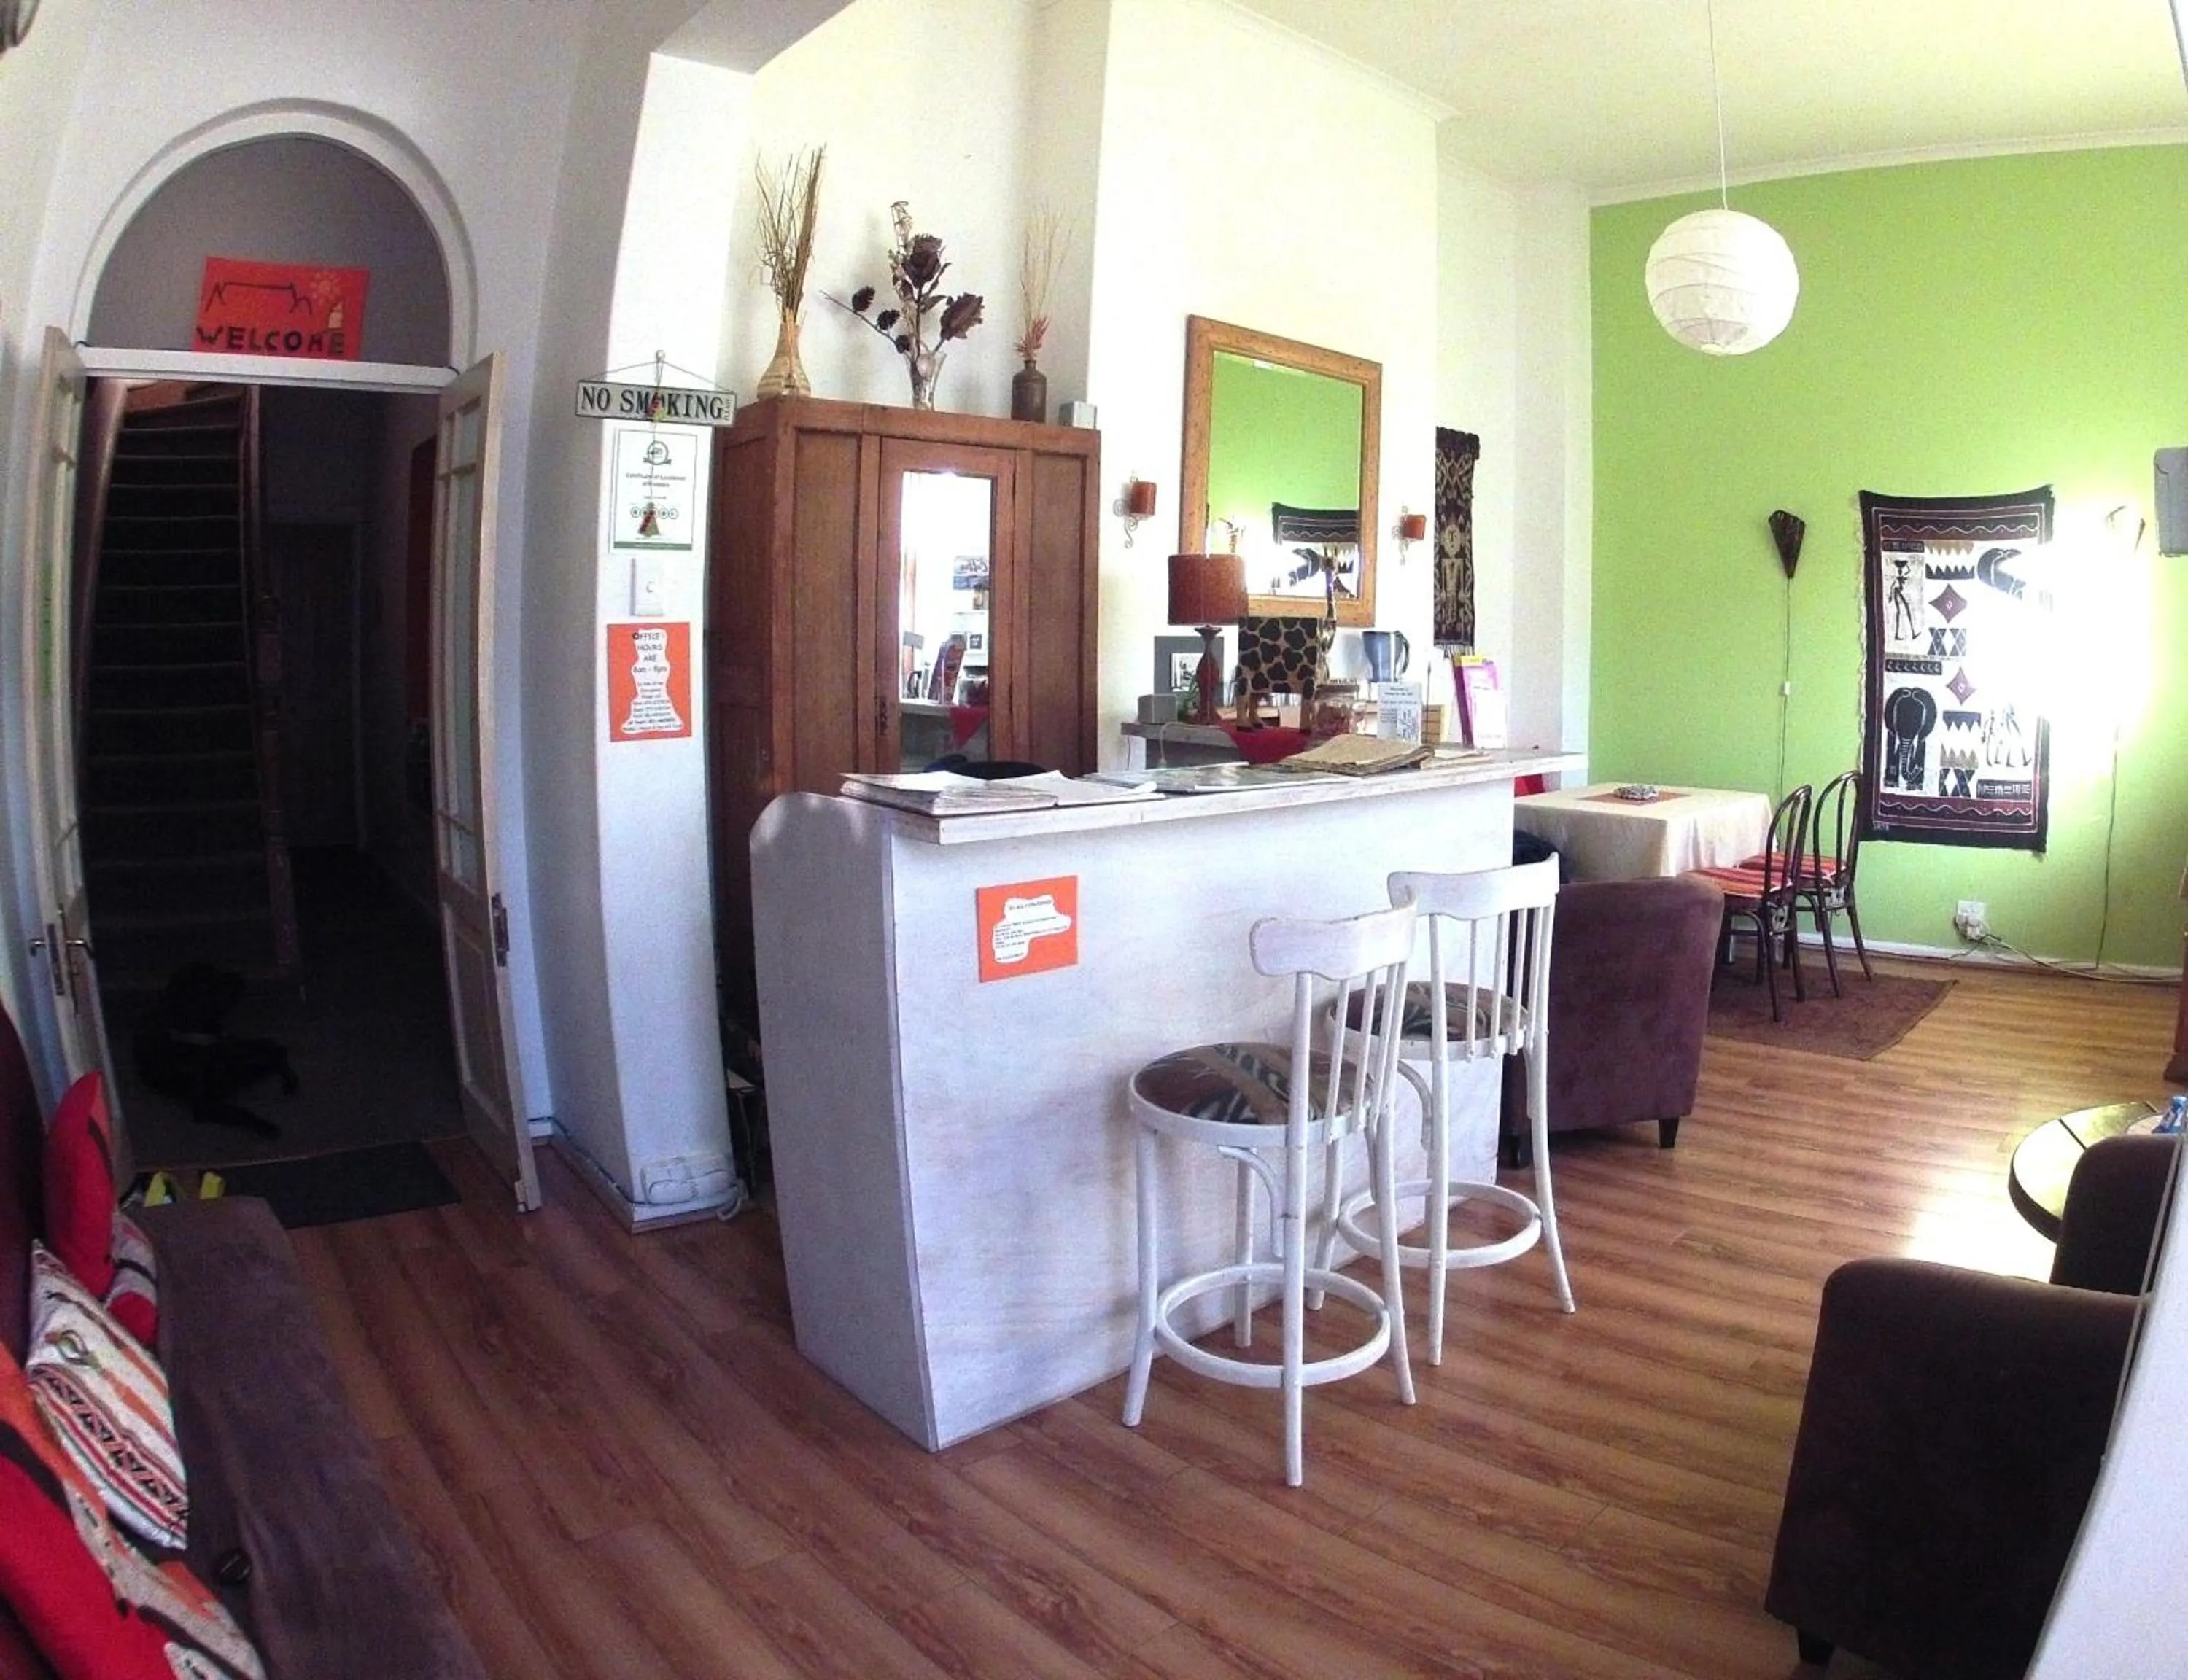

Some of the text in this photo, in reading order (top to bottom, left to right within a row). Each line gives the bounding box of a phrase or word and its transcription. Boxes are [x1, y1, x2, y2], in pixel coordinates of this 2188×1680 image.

[196, 325, 346, 354] WELCOME
[581, 386, 611, 411] NO
[632, 632, 660, 640] OFFICE
